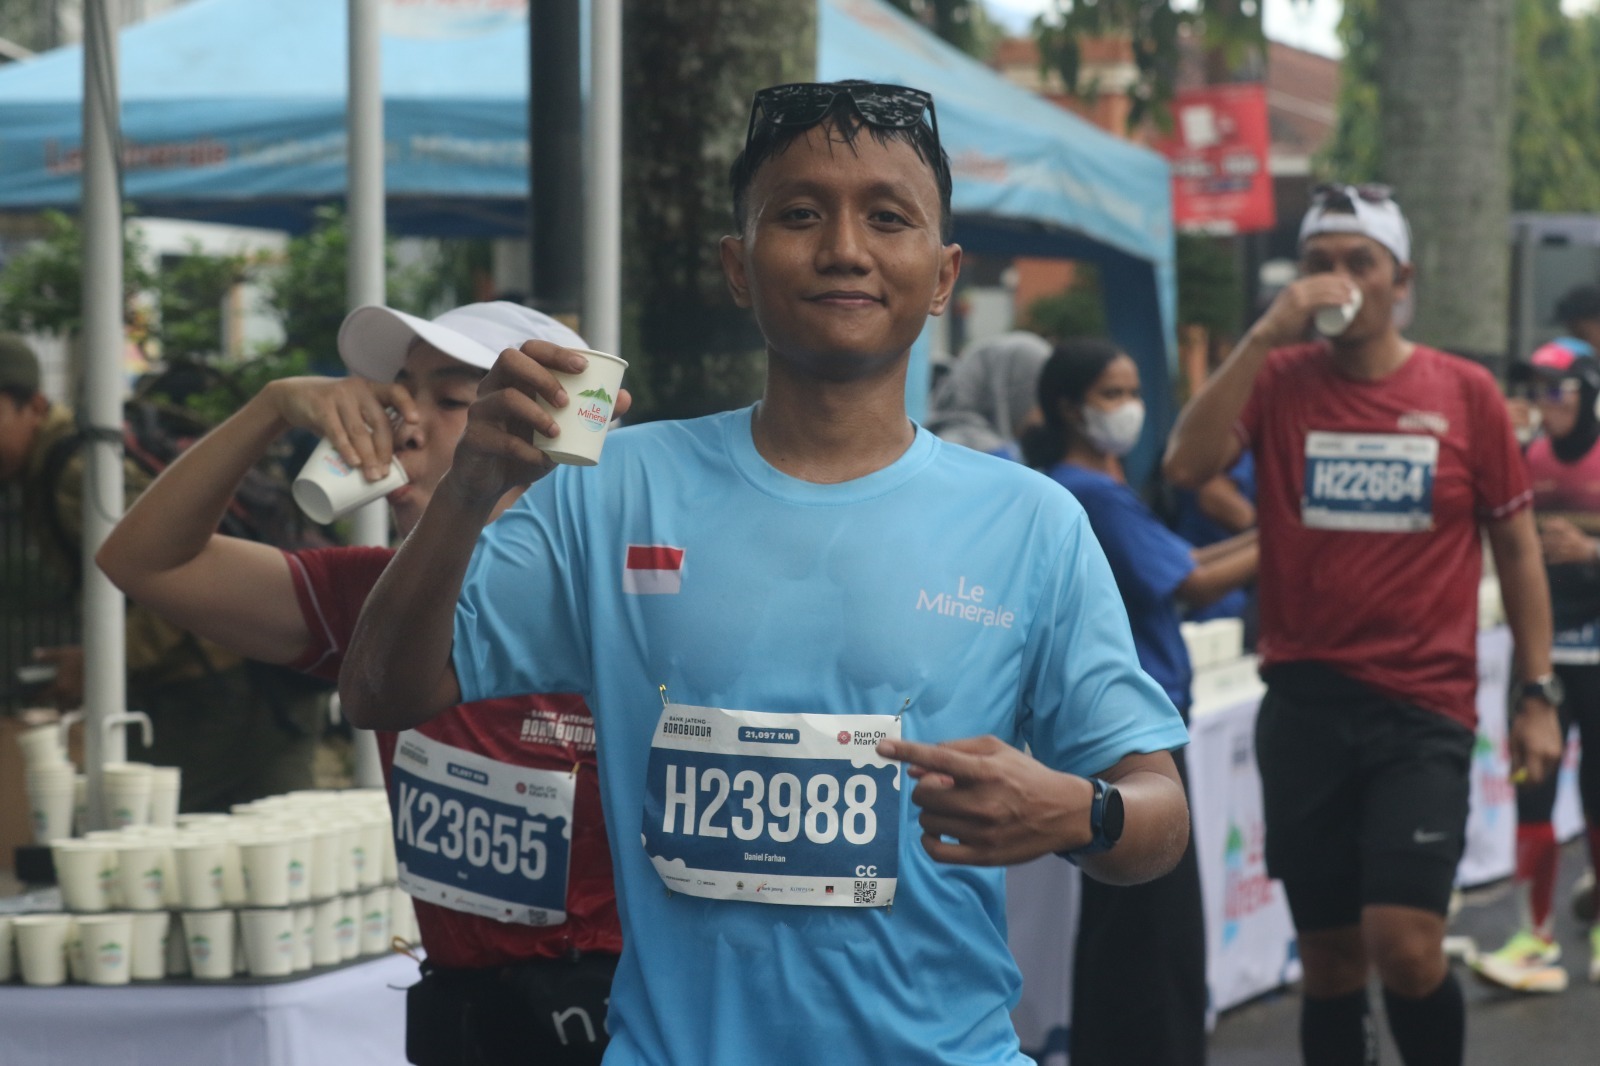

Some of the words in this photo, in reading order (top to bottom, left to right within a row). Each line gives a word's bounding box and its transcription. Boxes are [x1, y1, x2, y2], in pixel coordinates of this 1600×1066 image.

[591, 403, 601, 414] Le
[957, 575, 985, 603] Le
[915, 588, 1015, 629] Minerale
[669, 715, 684, 723] BANK
[684, 717, 707, 725] JATENG
[663, 722, 712, 738] BOROBUDUR
[745, 730, 776, 740] 21,097
[777, 732, 794, 741] KM
[854, 730, 872, 738] Run
[873, 731, 887, 739] On
[853, 737, 878, 746] Mark
[662, 764, 877, 845] H23988
[397, 781, 548, 881] K23655
[744, 852, 764, 861] Daniel
[764, 853, 786, 863] Farhan
[855, 865, 877, 878] CC
